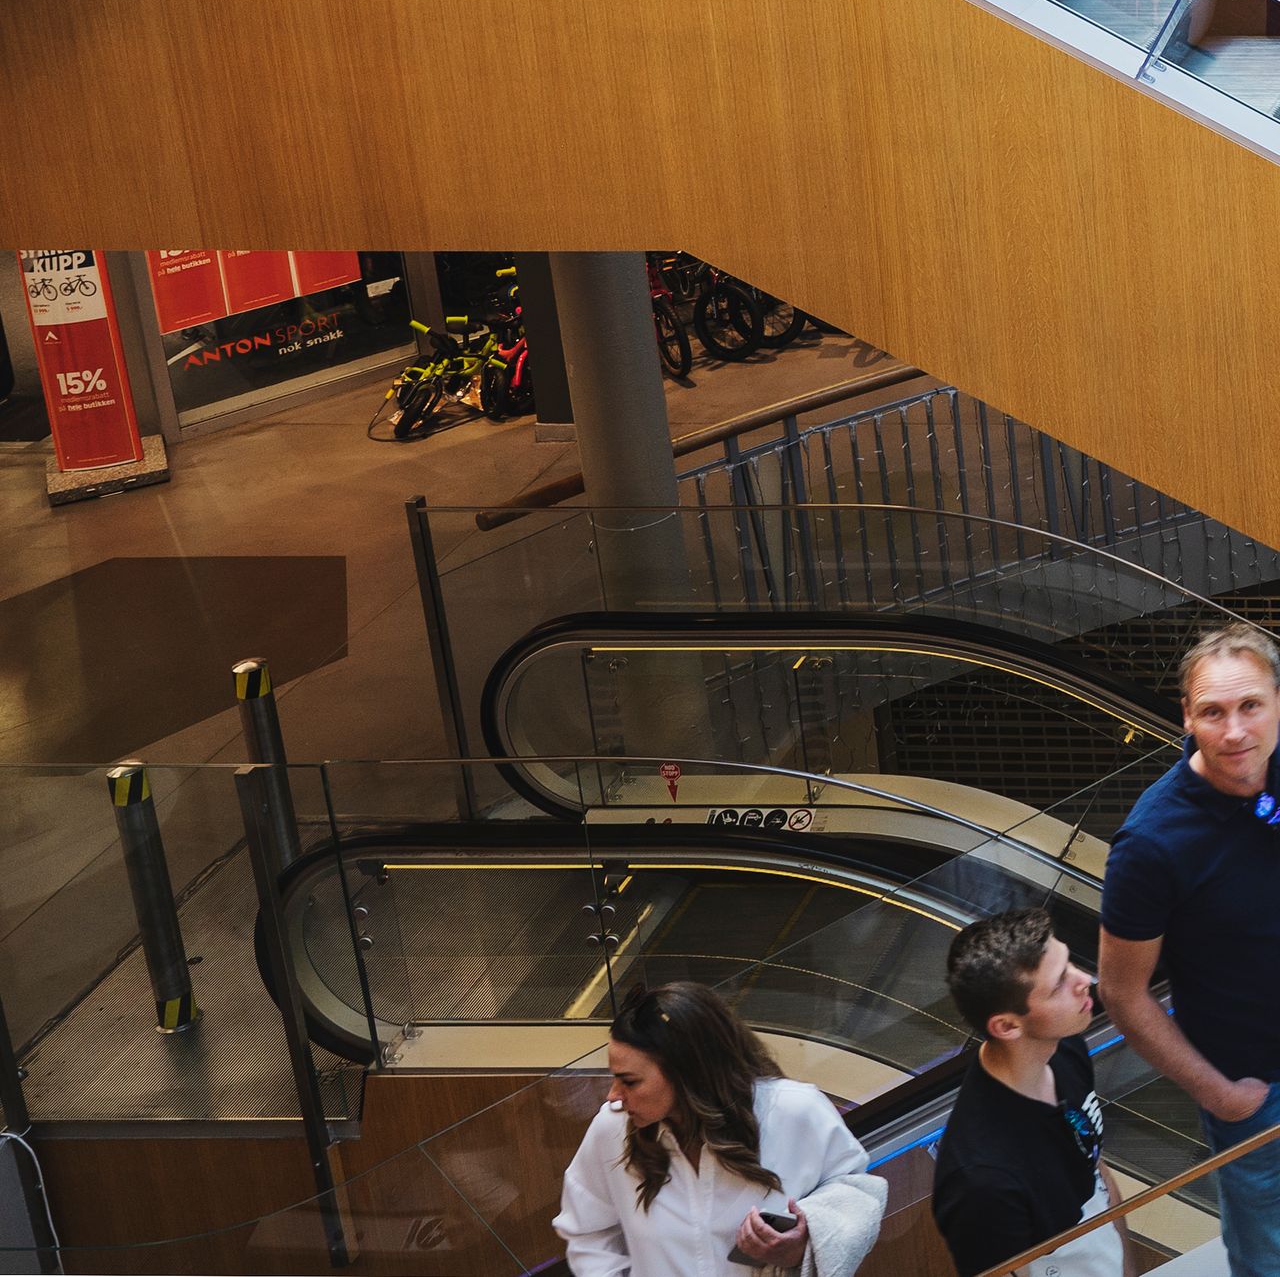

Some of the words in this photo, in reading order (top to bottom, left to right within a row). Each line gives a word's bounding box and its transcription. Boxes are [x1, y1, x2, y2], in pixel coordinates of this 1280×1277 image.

[33, 252, 86, 273] KUPP
[181, 258, 212, 270] butikken
[184, 333, 272, 370] ANTON
[275, 313, 342, 344] SPORT
[278, 342, 302, 356] nok
[306, 329, 344, 347] snakk
[56, 368, 107, 395] 15%
[67, 404, 83, 412] hele
[83, 399, 116, 410] butikken
